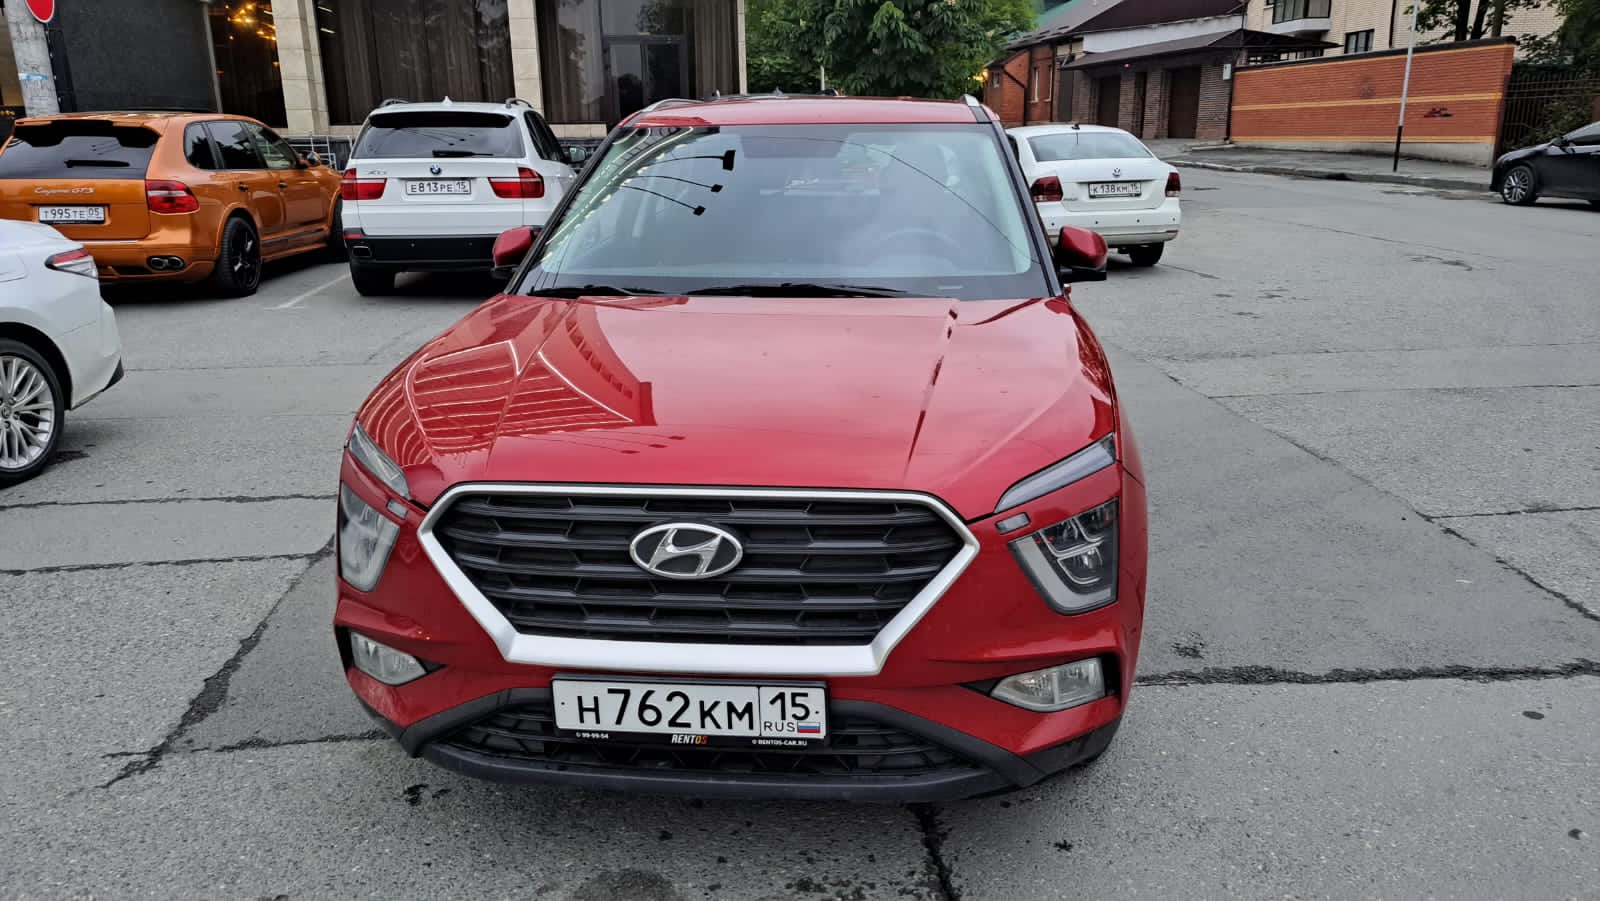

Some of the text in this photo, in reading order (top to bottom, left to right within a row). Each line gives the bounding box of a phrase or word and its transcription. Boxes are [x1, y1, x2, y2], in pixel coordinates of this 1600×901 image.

[410, 182, 453, 193] Е813РЕ
[43, 207, 100, 219] Т995ТЕ 05
[577, 688, 810, 731] Н762КМ 15
[763, 721, 796, 733] RUS
[671, 734, 708, 745] RENTOS
